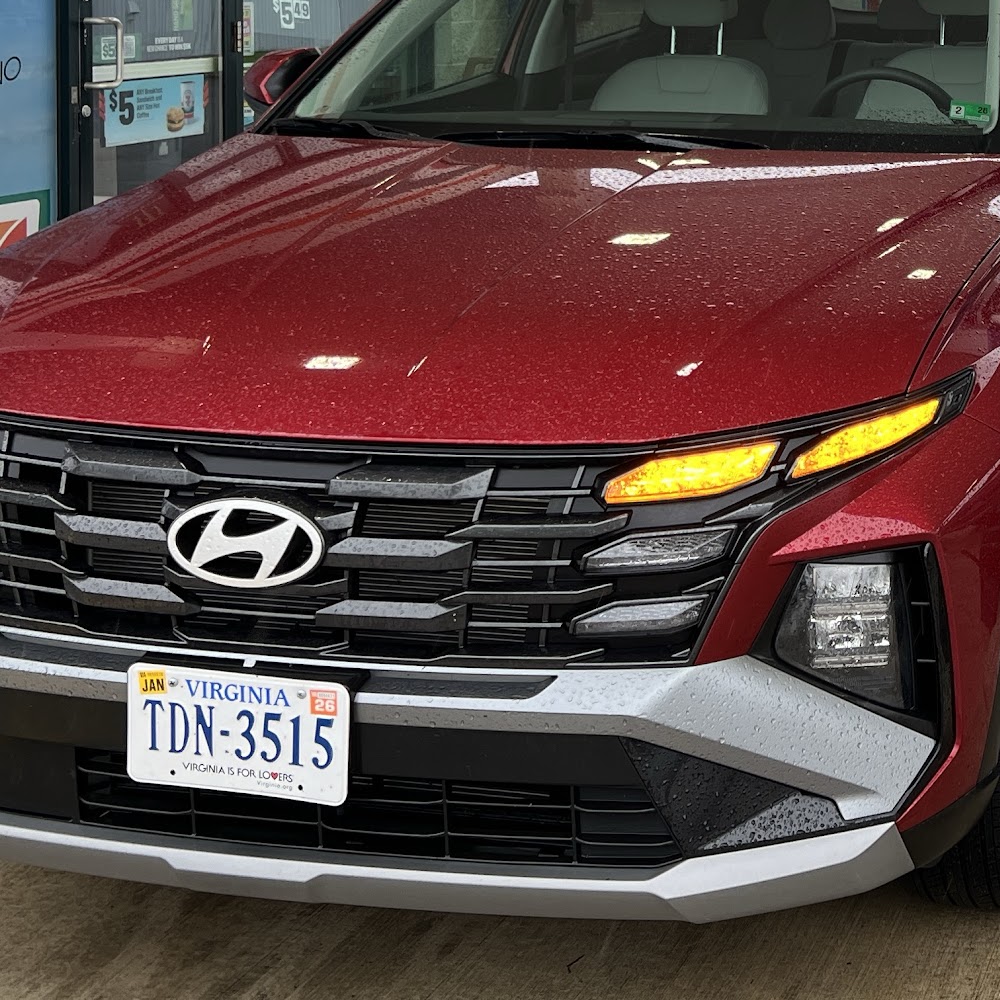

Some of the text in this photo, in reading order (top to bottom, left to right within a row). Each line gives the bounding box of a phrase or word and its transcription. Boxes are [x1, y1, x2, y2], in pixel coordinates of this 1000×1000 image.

[109, 89, 135, 125] $5
[955, 106, 962, 115] 2
[142, 678, 165, 692] JAN
[185, 678, 291, 707] VIRGINIA
[314, 698, 336, 713] 26
[143, 699, 335, 770] TDN-3515
[182, 762, 226, 775] VIRGINIA
[227, 766, 235, 776] IS
[237, 767, 257, 778] FOR
[256, 780, 293, 792] Virginia.org
